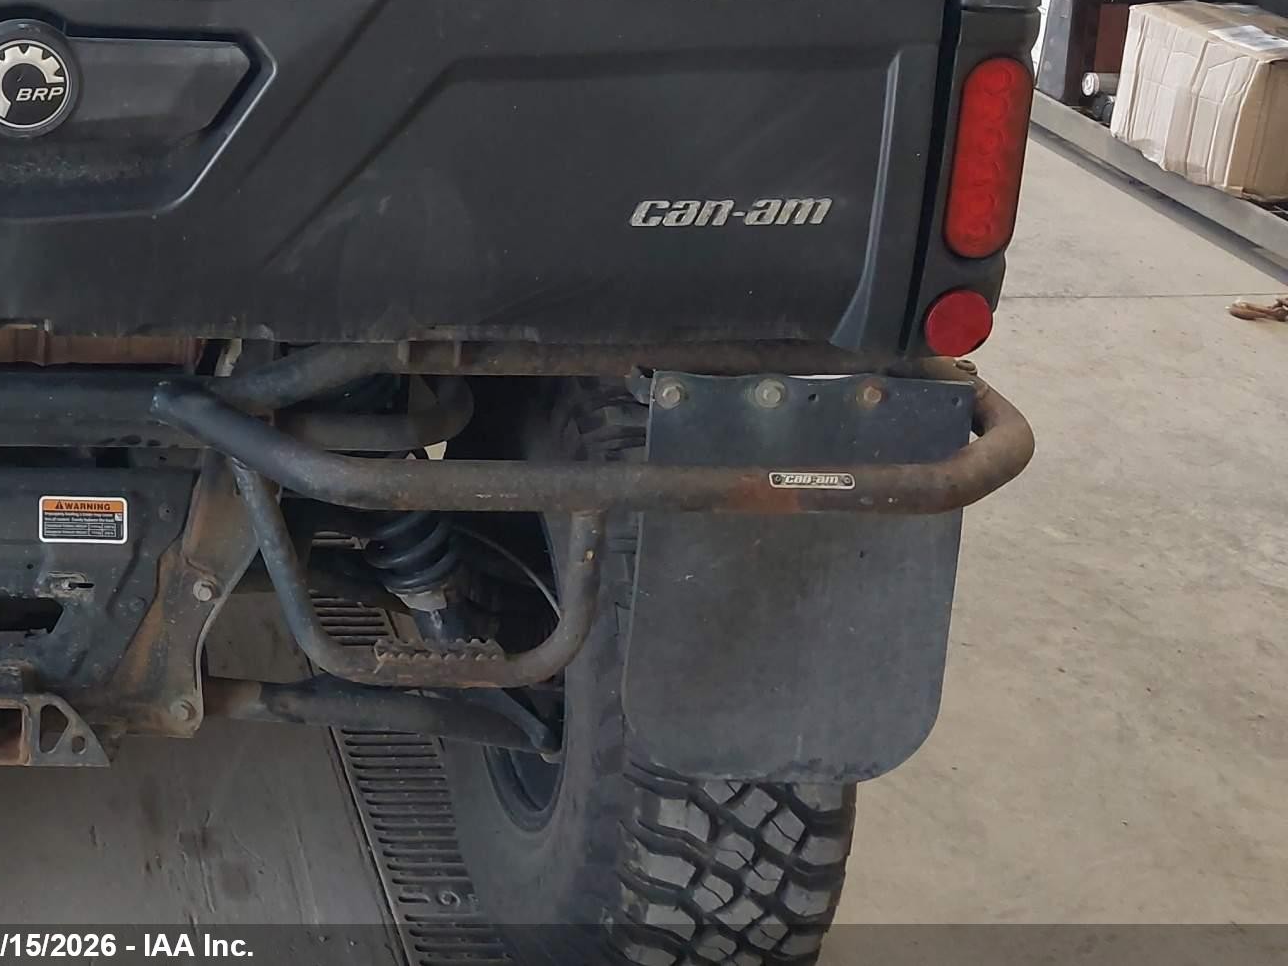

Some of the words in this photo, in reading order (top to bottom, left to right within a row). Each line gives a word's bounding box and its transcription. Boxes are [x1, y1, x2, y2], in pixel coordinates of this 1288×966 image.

[15, 87, 65, 102] BRP
[630, 198, 833, 227] can-am
[784, 475, 839, 484] can-am
[65, 502, 111, 511] WARNING
